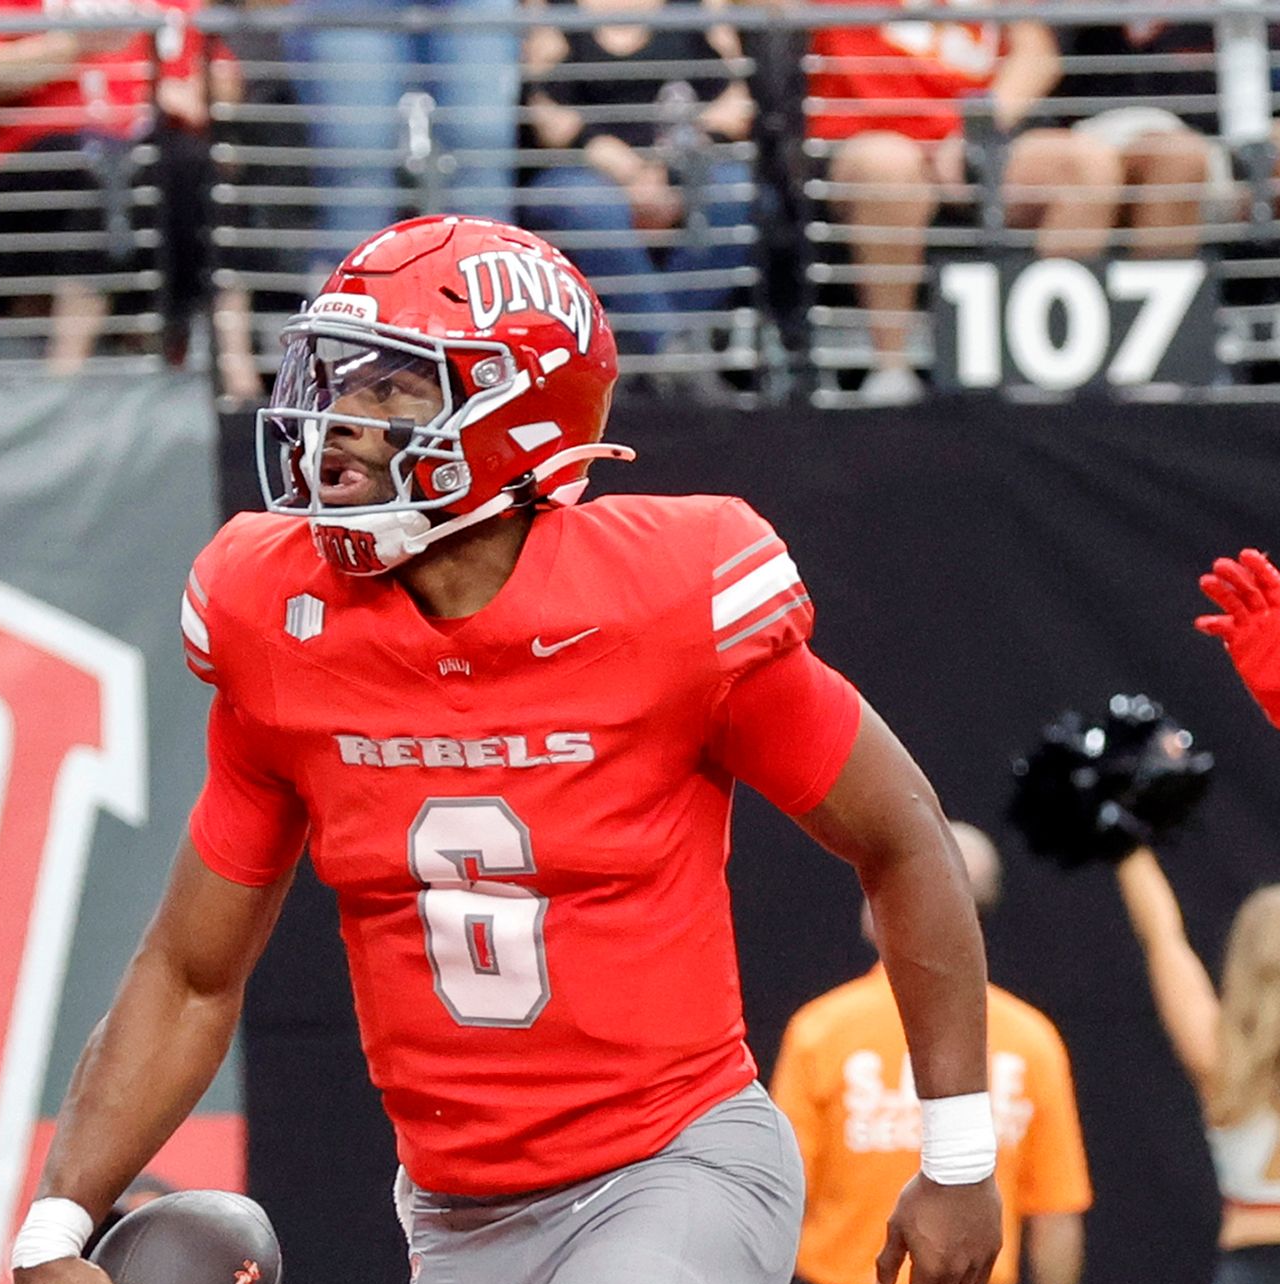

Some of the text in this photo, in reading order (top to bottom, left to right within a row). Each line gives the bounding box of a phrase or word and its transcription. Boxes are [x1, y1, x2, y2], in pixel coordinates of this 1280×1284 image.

[312, 301, 368, 319] VEGAS
[458, 251, 593, 355] UNLV
[939, 258, 1207, 391] 107
[333, 731, 597, 769] REBELS
[406, 796, 553, 1029] 6
